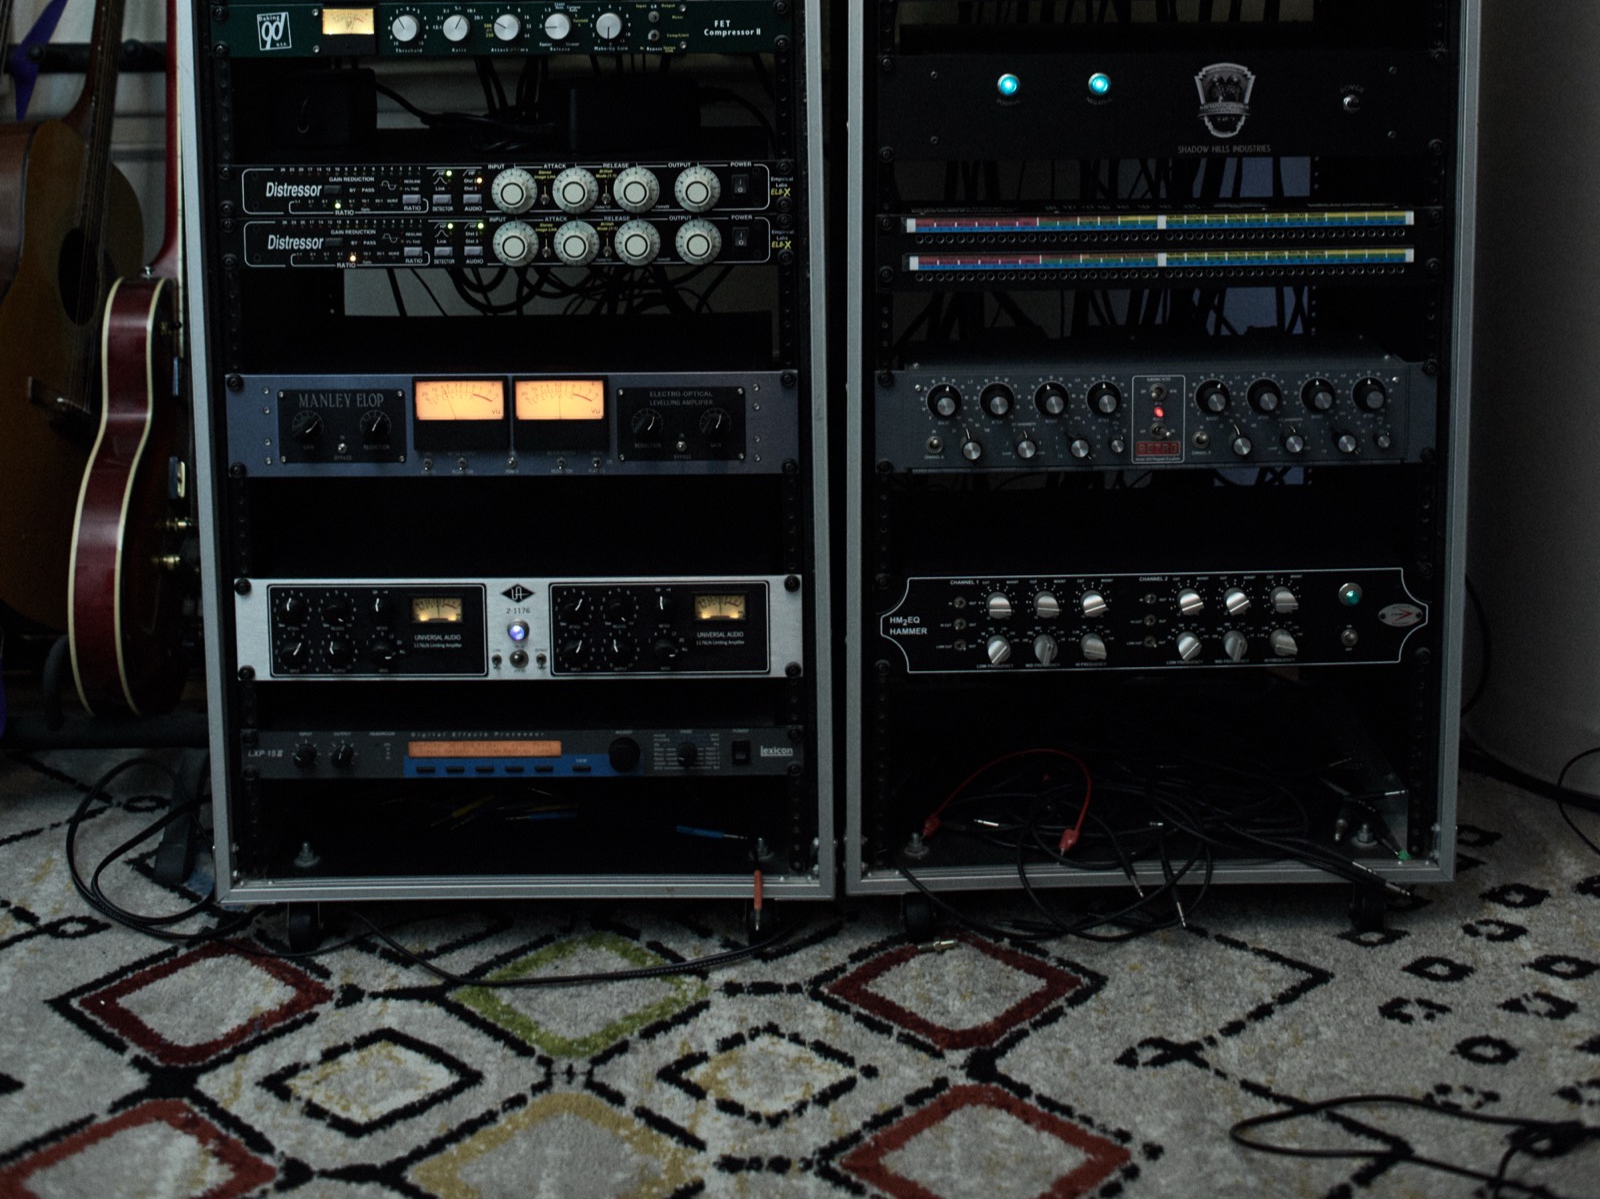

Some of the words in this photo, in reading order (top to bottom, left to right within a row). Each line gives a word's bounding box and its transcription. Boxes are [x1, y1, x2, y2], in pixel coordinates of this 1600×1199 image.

[714, 19, 731, 28] FET
[704, 27, 755, 38] Compressor
[1177, 144, 1209, 154] SHADOW
[1211, 144, 1230, 153] HILLS
[1232, 144, 1271, 153] INDUSTRIES
[265, 181, 323, 198] Distressor
[267, 234, 325, 251] Distressor
[649, 390, 713, 398] ELECTRO-OPTICAL
[298, 392, 352, 408] MANLEY
[356, 392, 385, 407] ELOP
[649, 398, 681, 406] LEVELLING
[1138, 443, 1178, 453] RETRO
[889, 627, 928, 636] HAMMER
[414, 633, 443, 641] UNIVERSAL
[444, 633, 462, 641] AUDIO
[759, 746, 794, 757] lexicon
